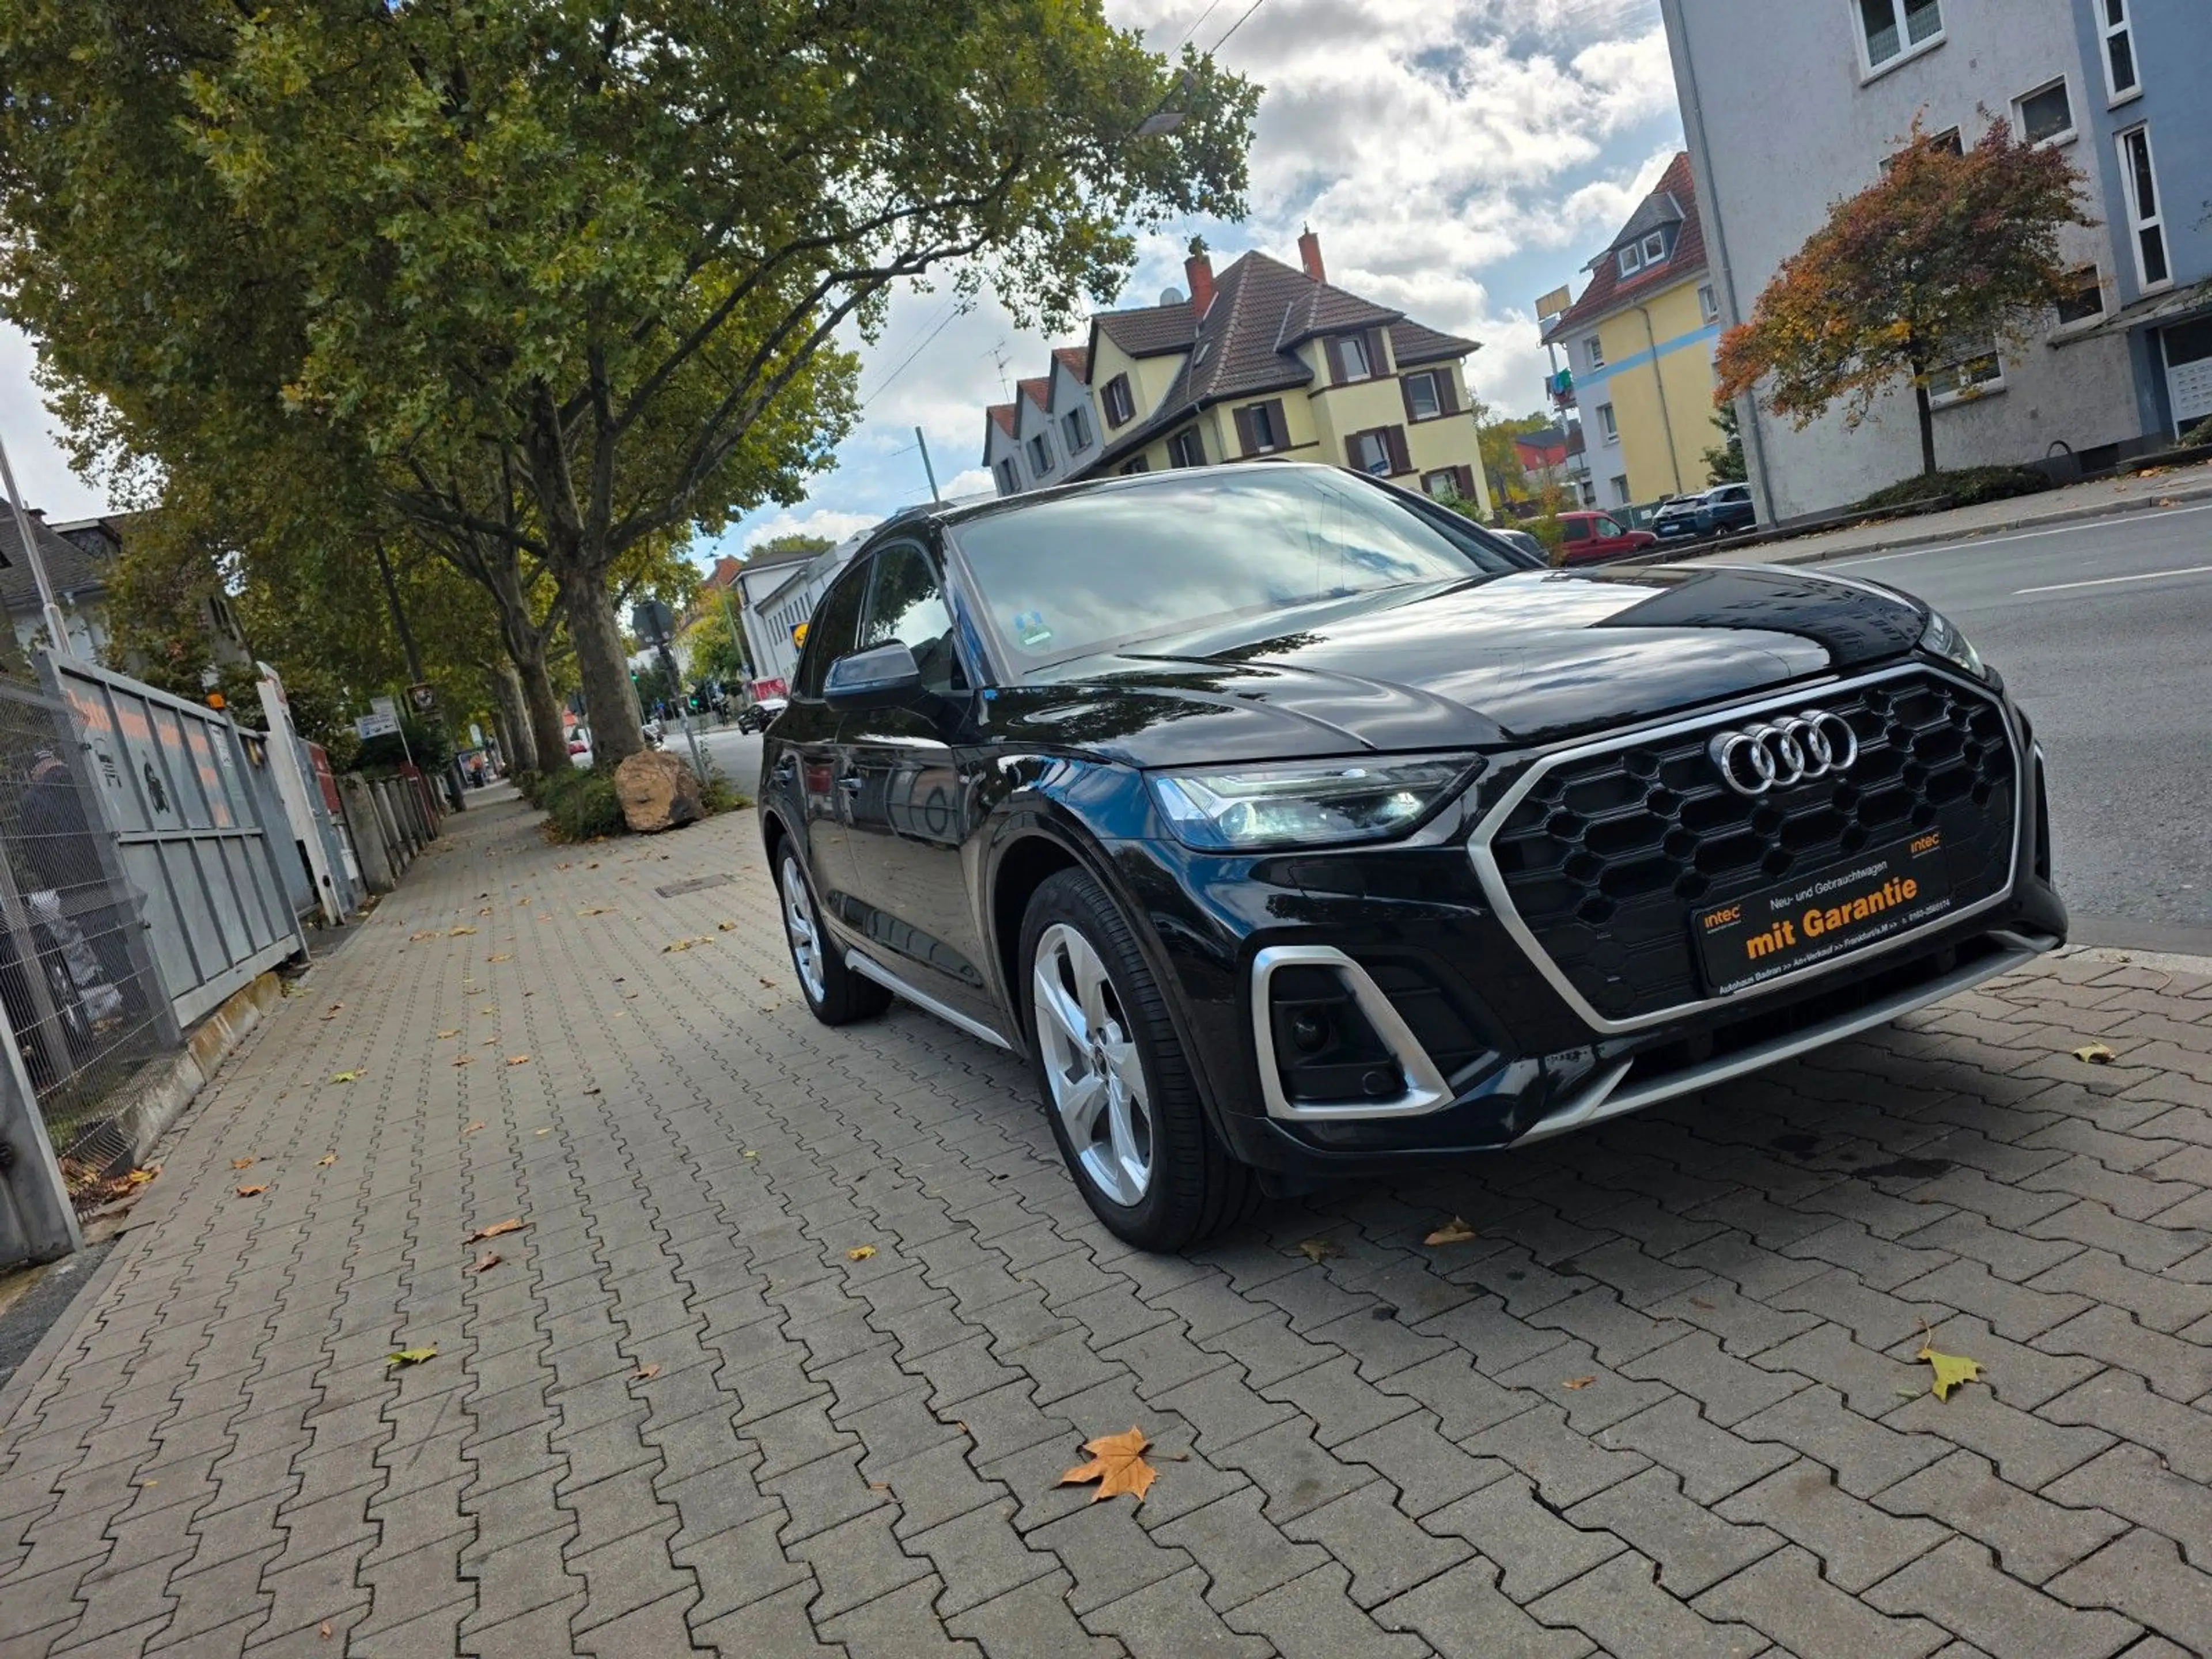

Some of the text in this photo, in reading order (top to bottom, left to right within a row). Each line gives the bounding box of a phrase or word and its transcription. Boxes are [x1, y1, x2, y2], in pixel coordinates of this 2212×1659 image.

[1911, 834, 1939, 853] intec
[1770, 861, 1888, 910] Neu- und Gebrauchtwagen
[1704, 907, 1740, 928] intec
[1747, 876, 1918, 959] mit Garantie
[1719, 976, 1754, 994] Autohaus
